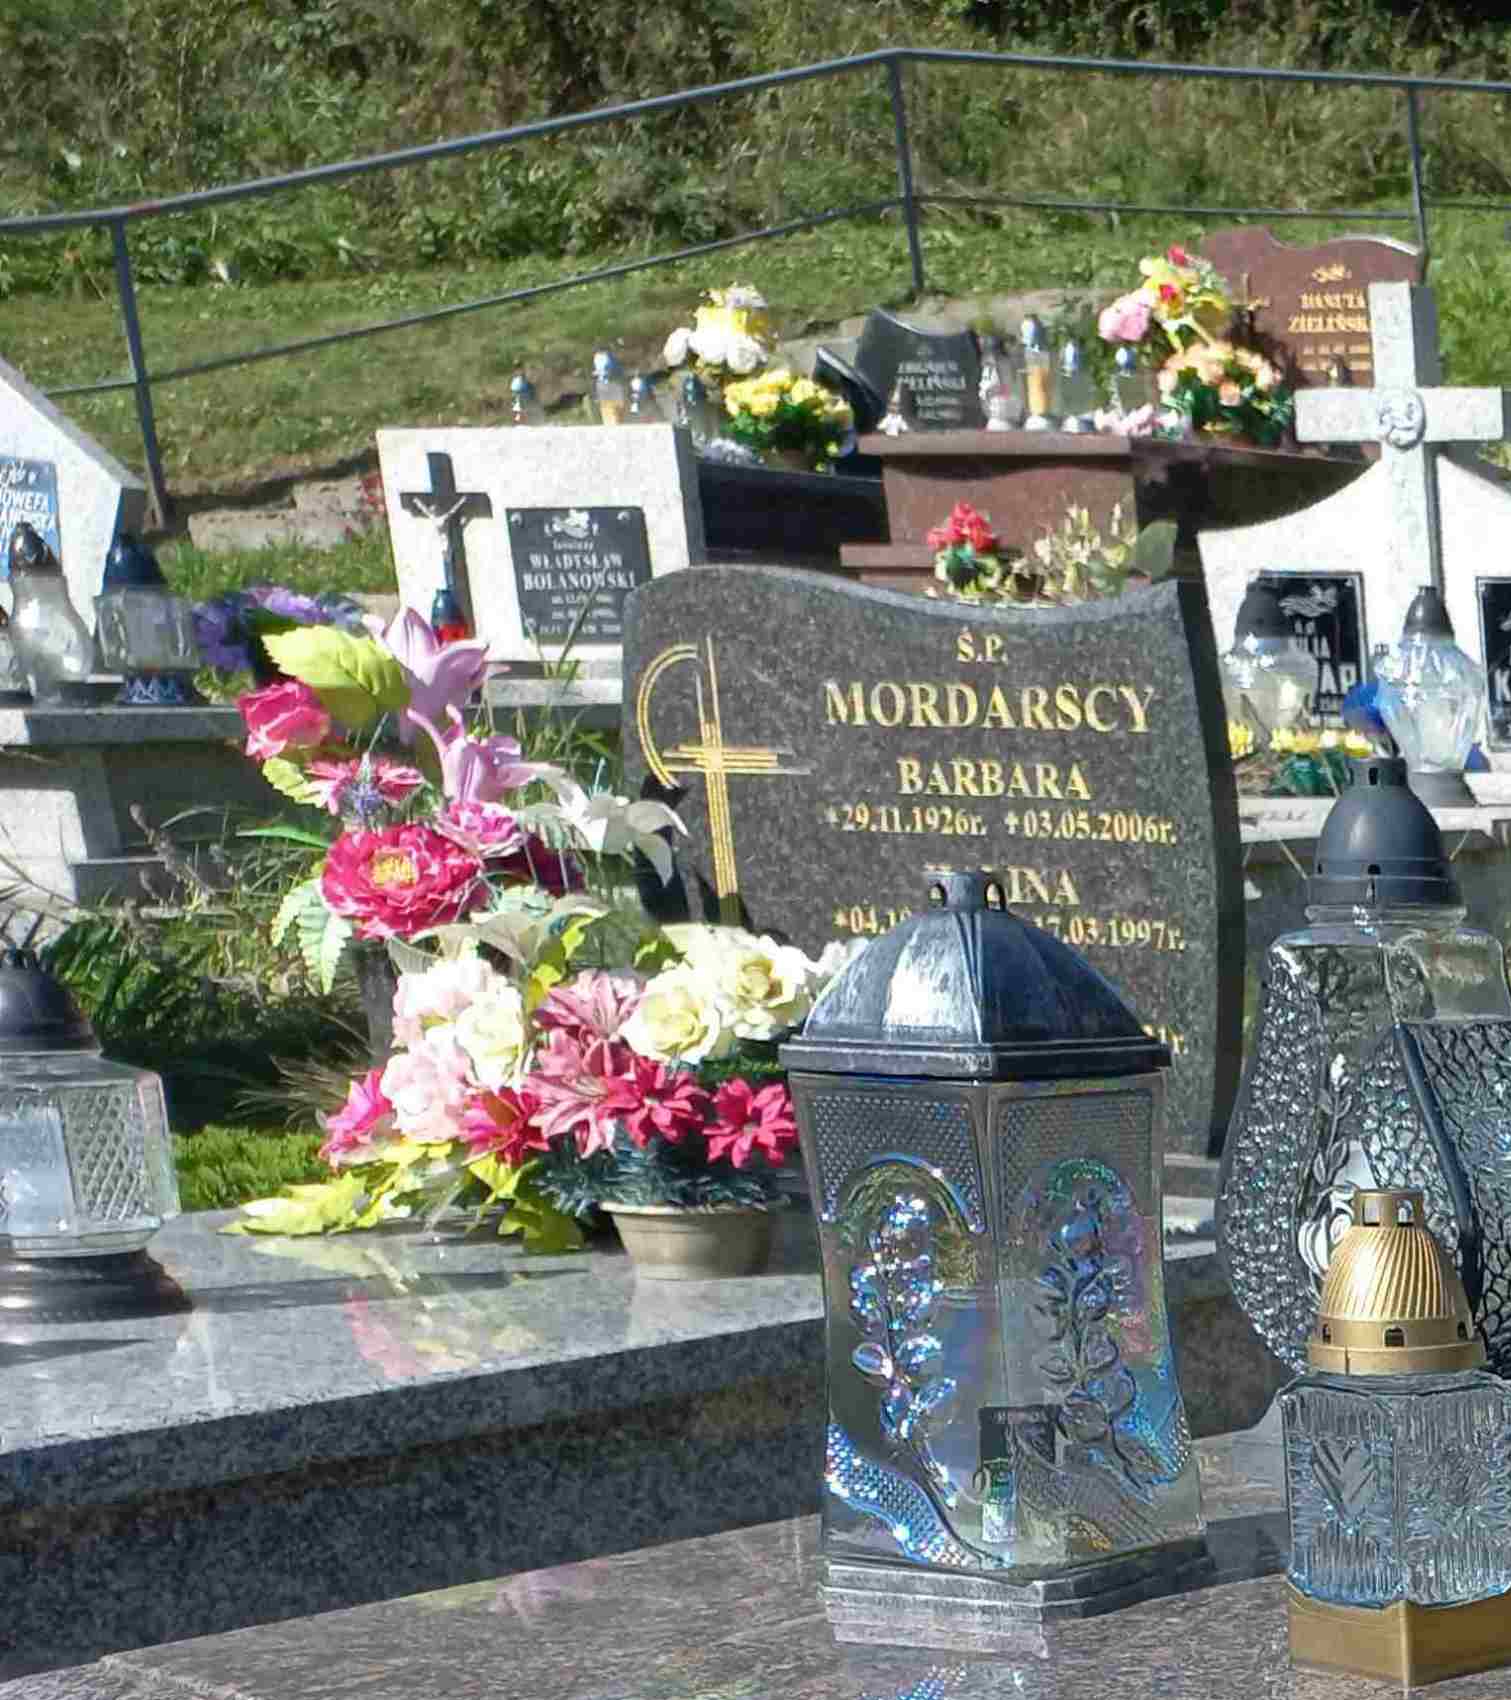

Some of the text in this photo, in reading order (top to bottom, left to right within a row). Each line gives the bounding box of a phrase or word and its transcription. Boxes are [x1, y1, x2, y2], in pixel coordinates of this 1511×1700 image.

[1288, 313, 1369, 333] ZIELIŃSK
[822, 679, 1154, 733] MORDARSCY
[897, 754, 1093, 800] BARBARA
